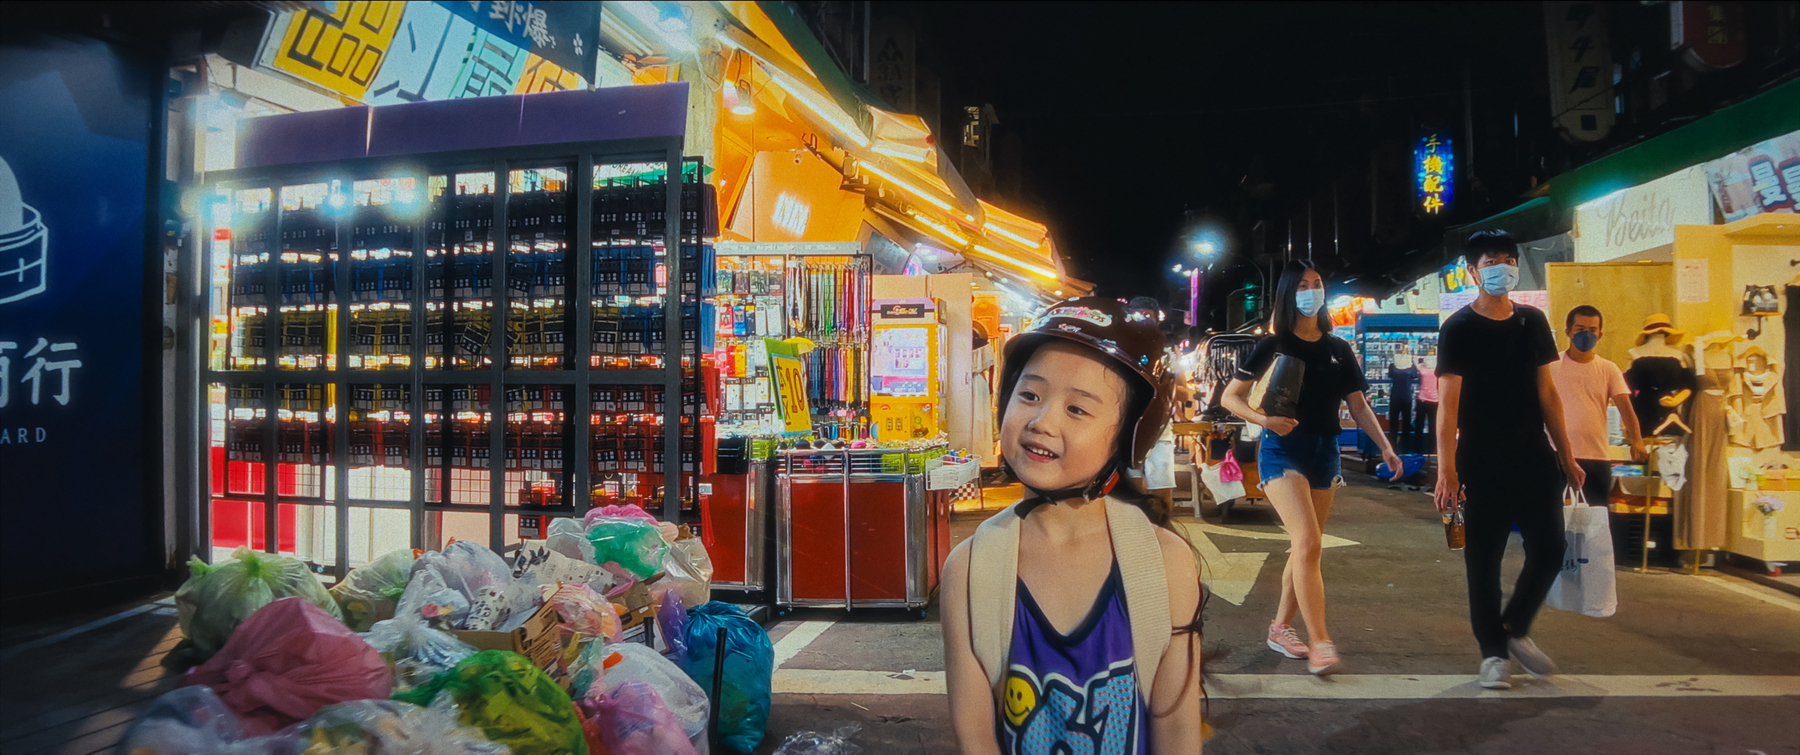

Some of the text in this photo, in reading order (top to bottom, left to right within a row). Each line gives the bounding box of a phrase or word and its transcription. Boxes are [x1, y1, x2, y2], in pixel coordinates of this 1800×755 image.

[1422, 133, 1445, 216] 手機配件
[0, 337, 82, 408] 行
[785, 367, 805, 414] 10
[0, 427, 47, 444] ARD
